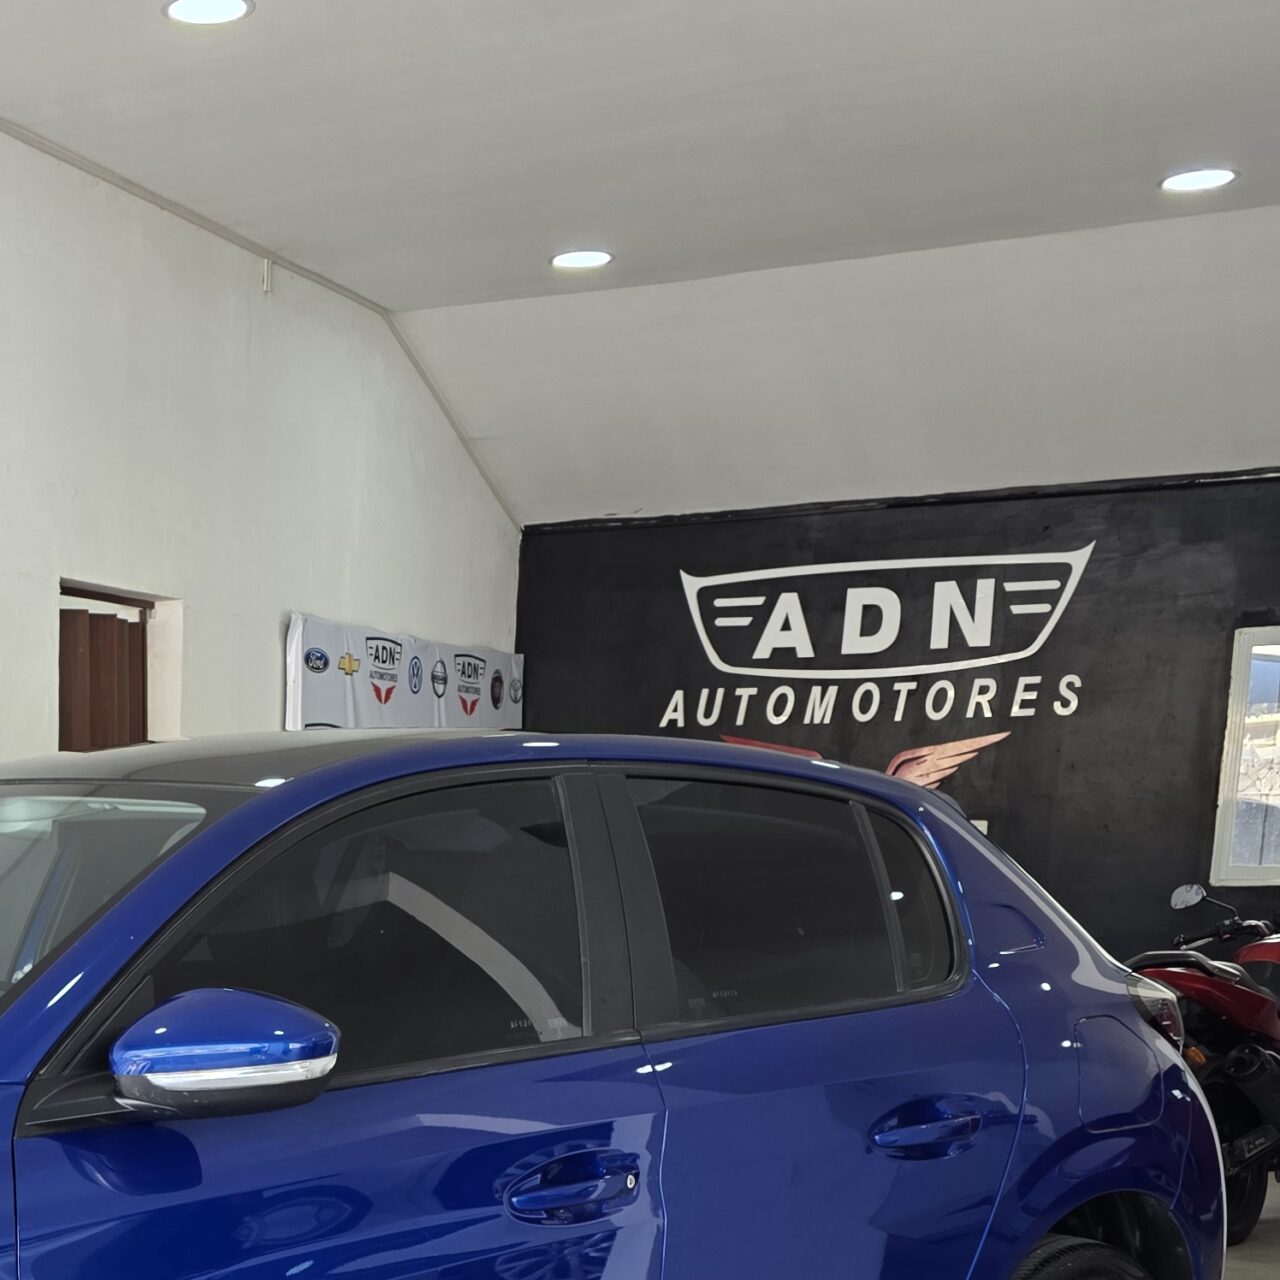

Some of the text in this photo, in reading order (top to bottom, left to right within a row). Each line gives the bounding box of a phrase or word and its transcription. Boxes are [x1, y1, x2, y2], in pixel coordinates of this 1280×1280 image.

[752, 578, 996, 660] ADN
[374, 644, 396, 666] ADN
[460, 660, 480, 681] ADN
[657, 673, 1083, 728] AUTOMOTORES
